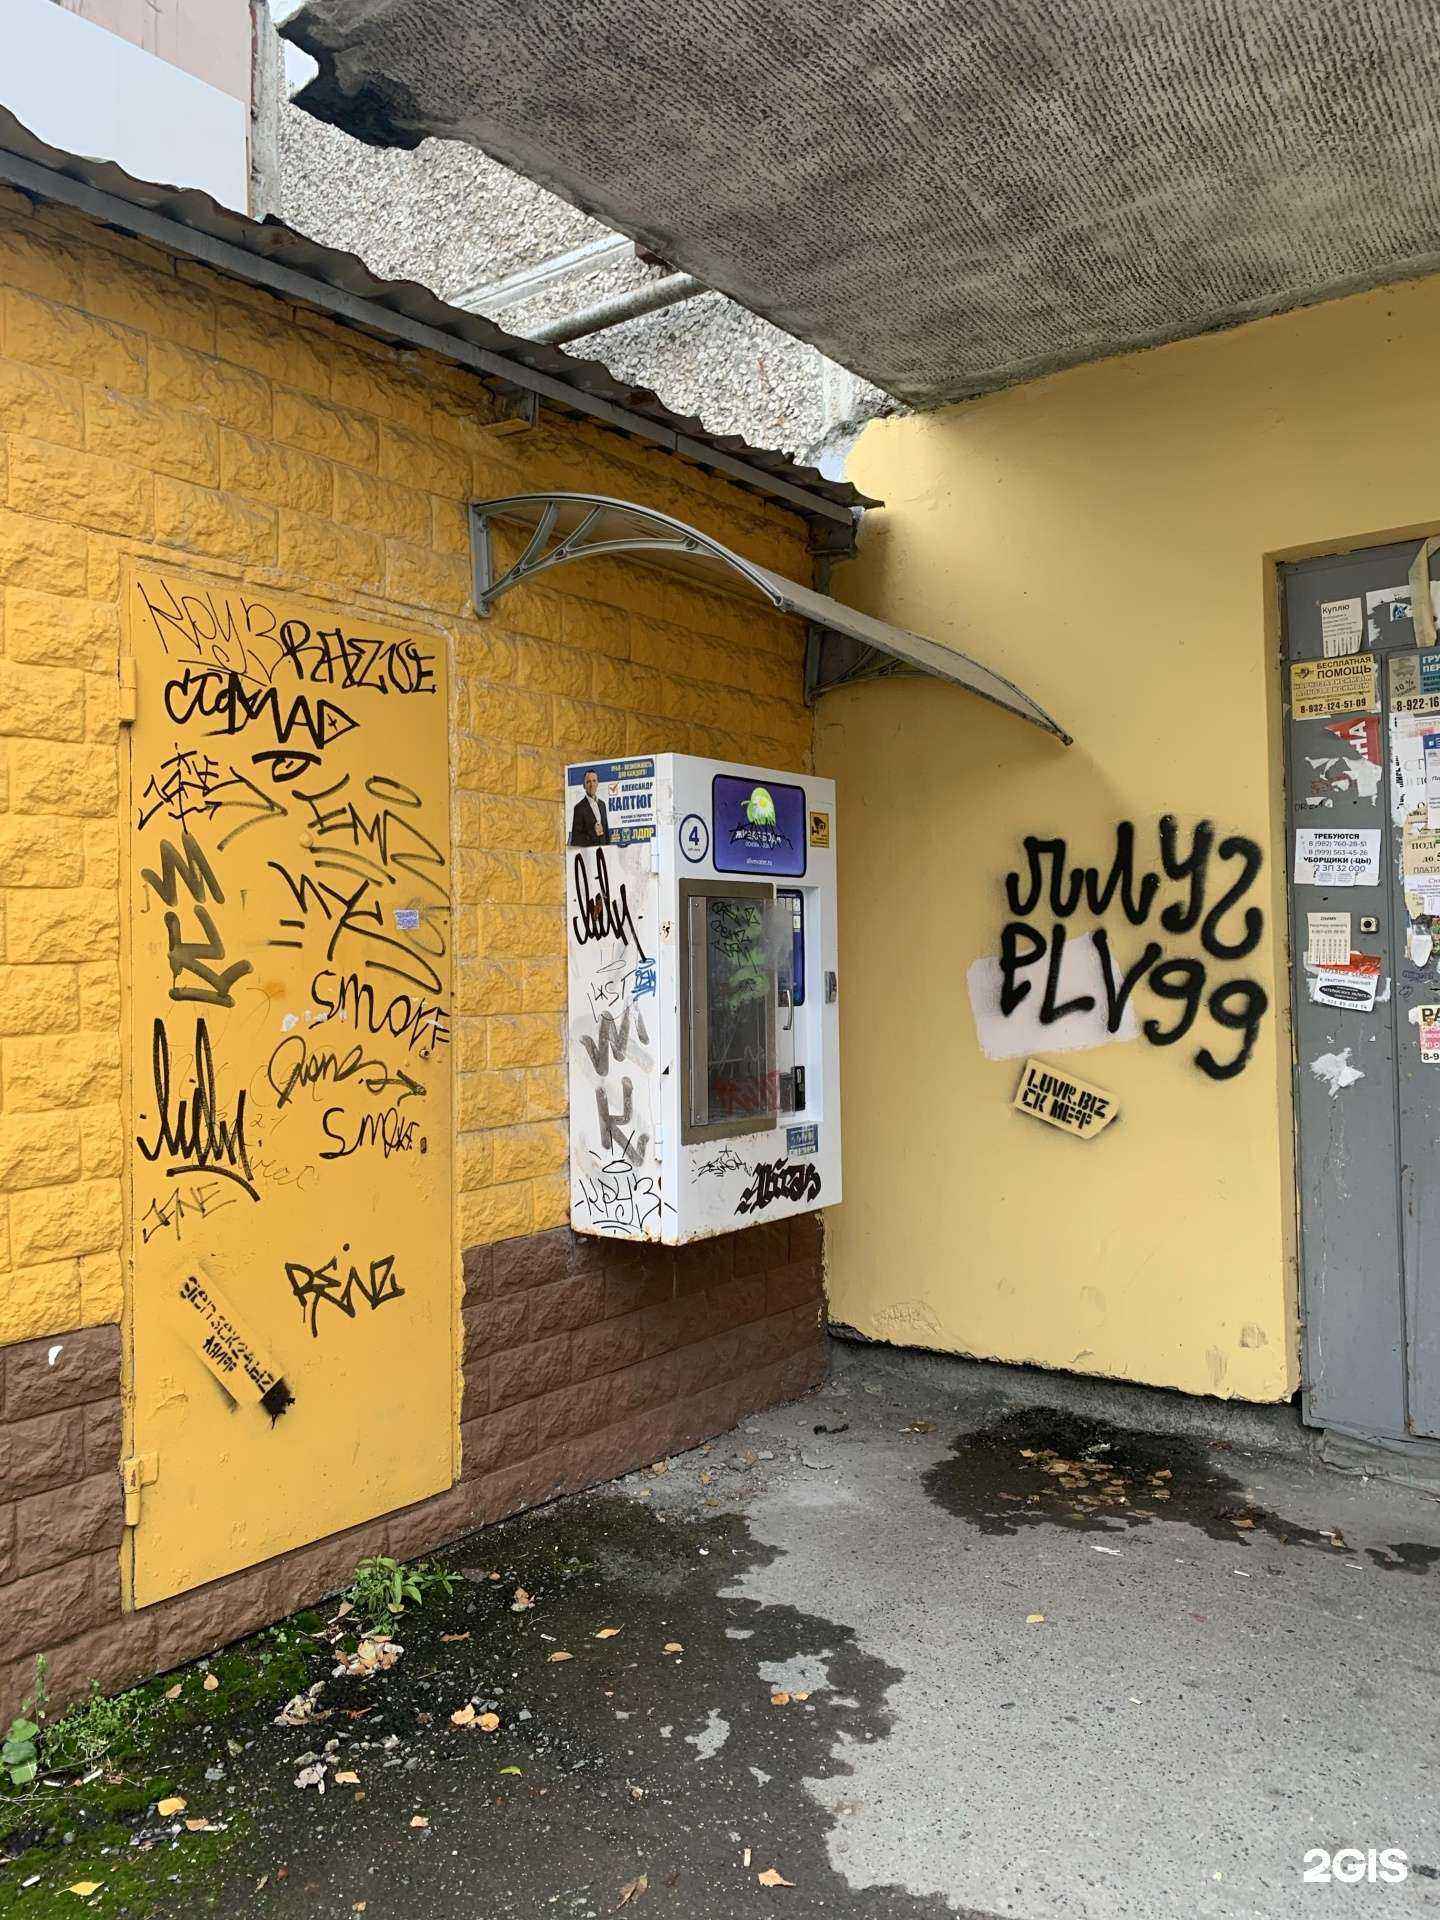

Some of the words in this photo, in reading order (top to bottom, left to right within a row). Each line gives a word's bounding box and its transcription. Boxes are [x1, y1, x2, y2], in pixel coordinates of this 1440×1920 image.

[1322, 604, 1350, 615] Куплю
[1316, 656, 1371, 669] БЕСПЛАТНАЯ
[1317, 666, 1372, 679] ПОМОЩЬ
[621, 782, 653, 792] АЛЕКСАНДР
[608, 794, 653, 812] КАПТЮГ
[632, 828, 654, 841] ЛДПР
[689, 826, 700, 845] 4
